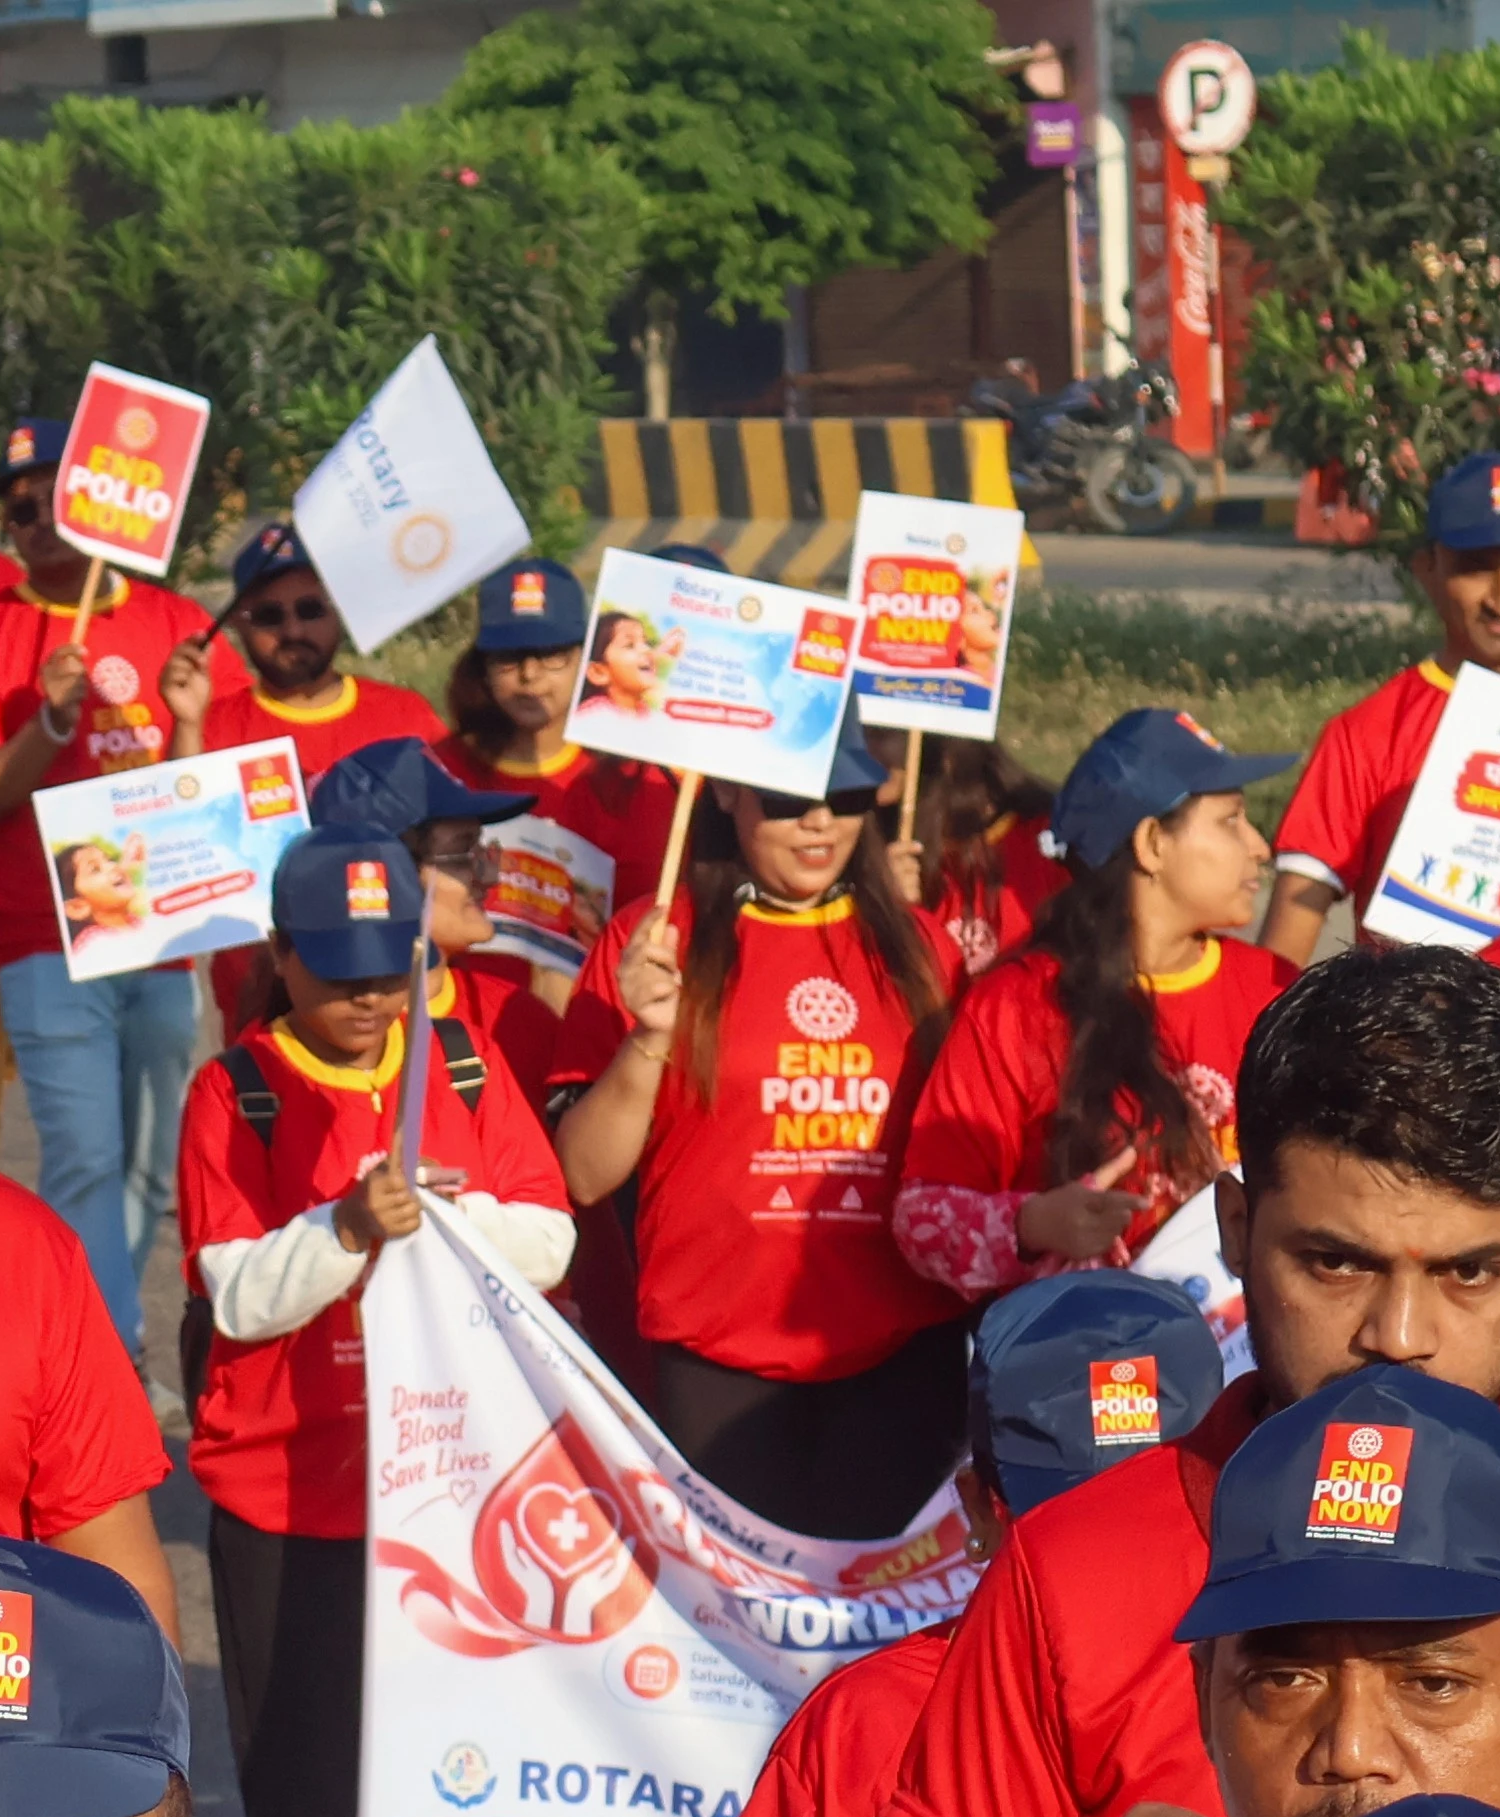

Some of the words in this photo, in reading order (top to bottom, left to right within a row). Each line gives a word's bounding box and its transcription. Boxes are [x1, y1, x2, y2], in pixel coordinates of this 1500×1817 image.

[1189, 68, 1226, 132] P
[88, 444, 163, 490] END
[66, 464, 171, 522] POLIO
[67, 492, 157, 542] NOW
[903, 570, 960, 596] END
[867, 593, 961, 621] POLIO
[878, 619, 950, 646] NOW
[778, 1041, 873, 1078] END
[762, 1076, 890, 1117] POLIO
[774, 1112, 880, 1149] NOW
[390, 1385, 468, 1418] Donate
[397, 1414, 465, 1455] Blood
[378, 1460, 426, 1497] Save
[435, 1447, 490, 1477] Lives
[1330, 1460, 1396, 1484] END
[1312, 1478, 1402, 1508] POLIO
[1318, 1500, 1396, 1526] NOW
